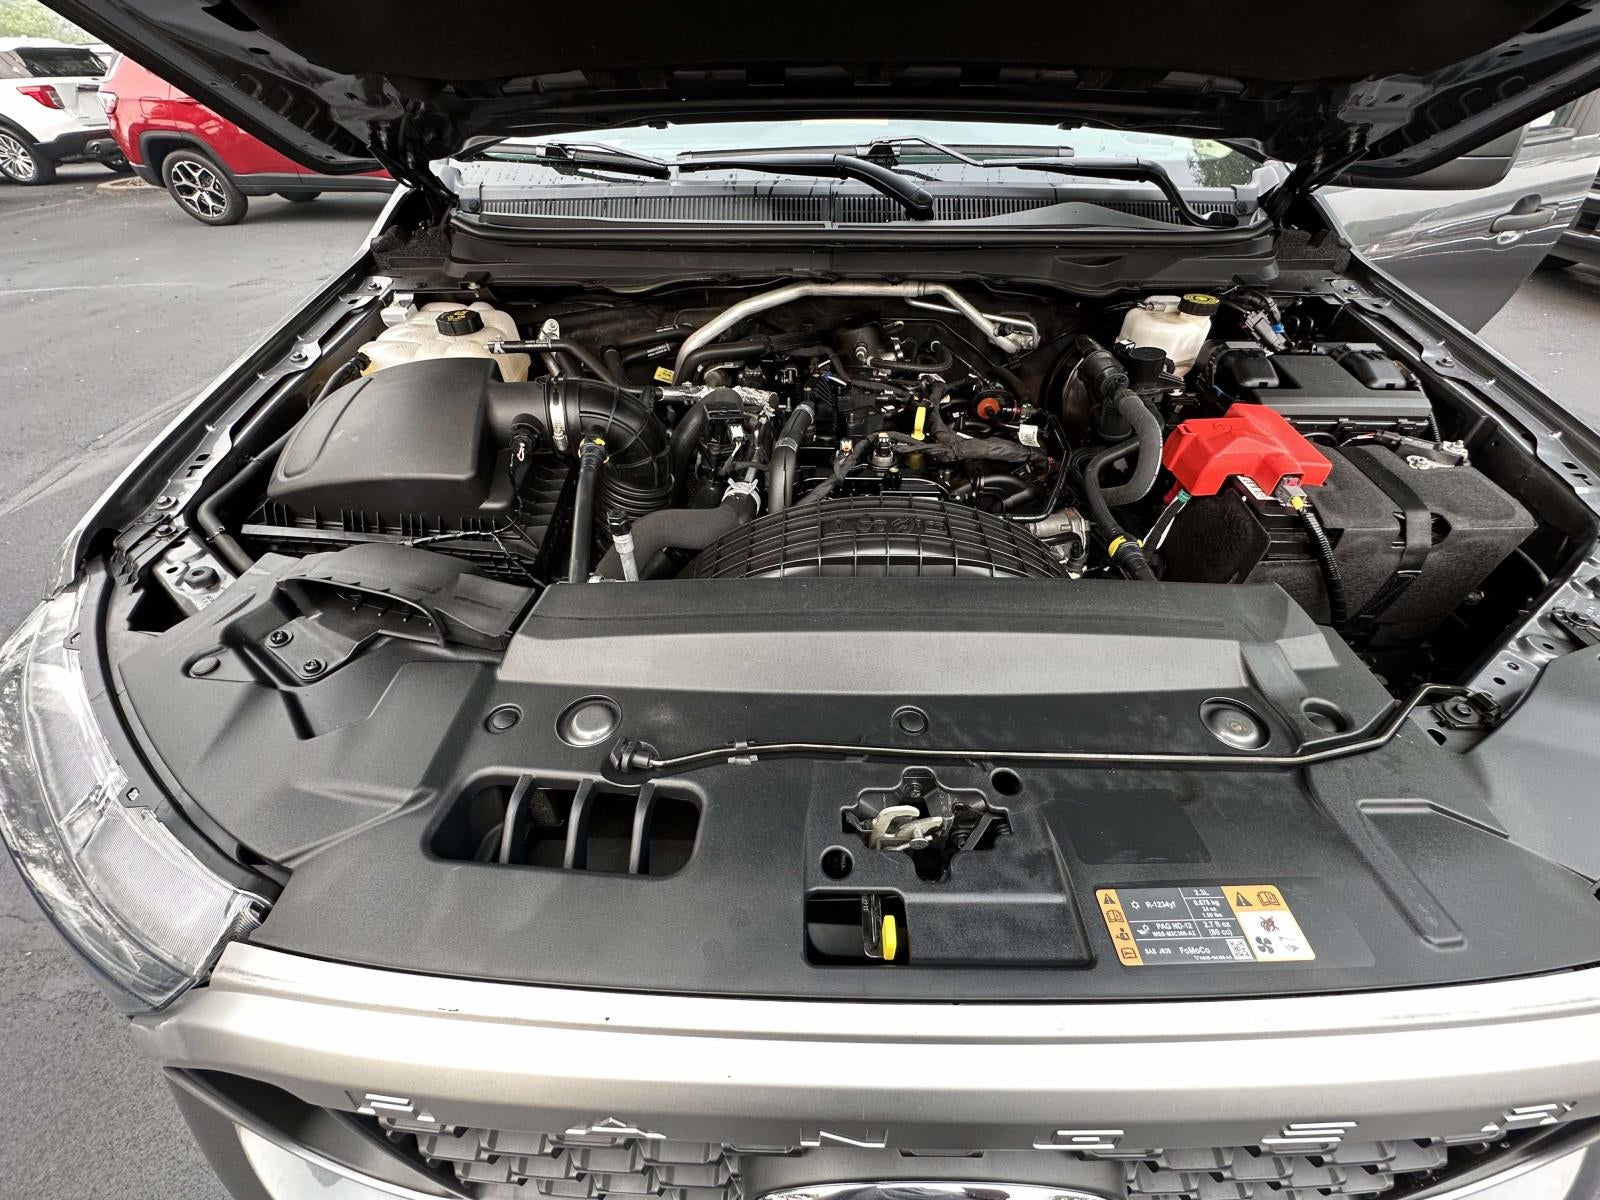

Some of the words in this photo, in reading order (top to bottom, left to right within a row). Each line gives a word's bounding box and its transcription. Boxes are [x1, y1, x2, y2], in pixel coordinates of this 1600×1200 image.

[1145, 901, 1176, 909] R-1234yf
[1155, 922, 1172, 930] PAG
[1203, 921, 1214, 929] 2.7
[1221, 928, 1233, 937] cc)
[1179, 946, 1210, 955] FoMoCo
